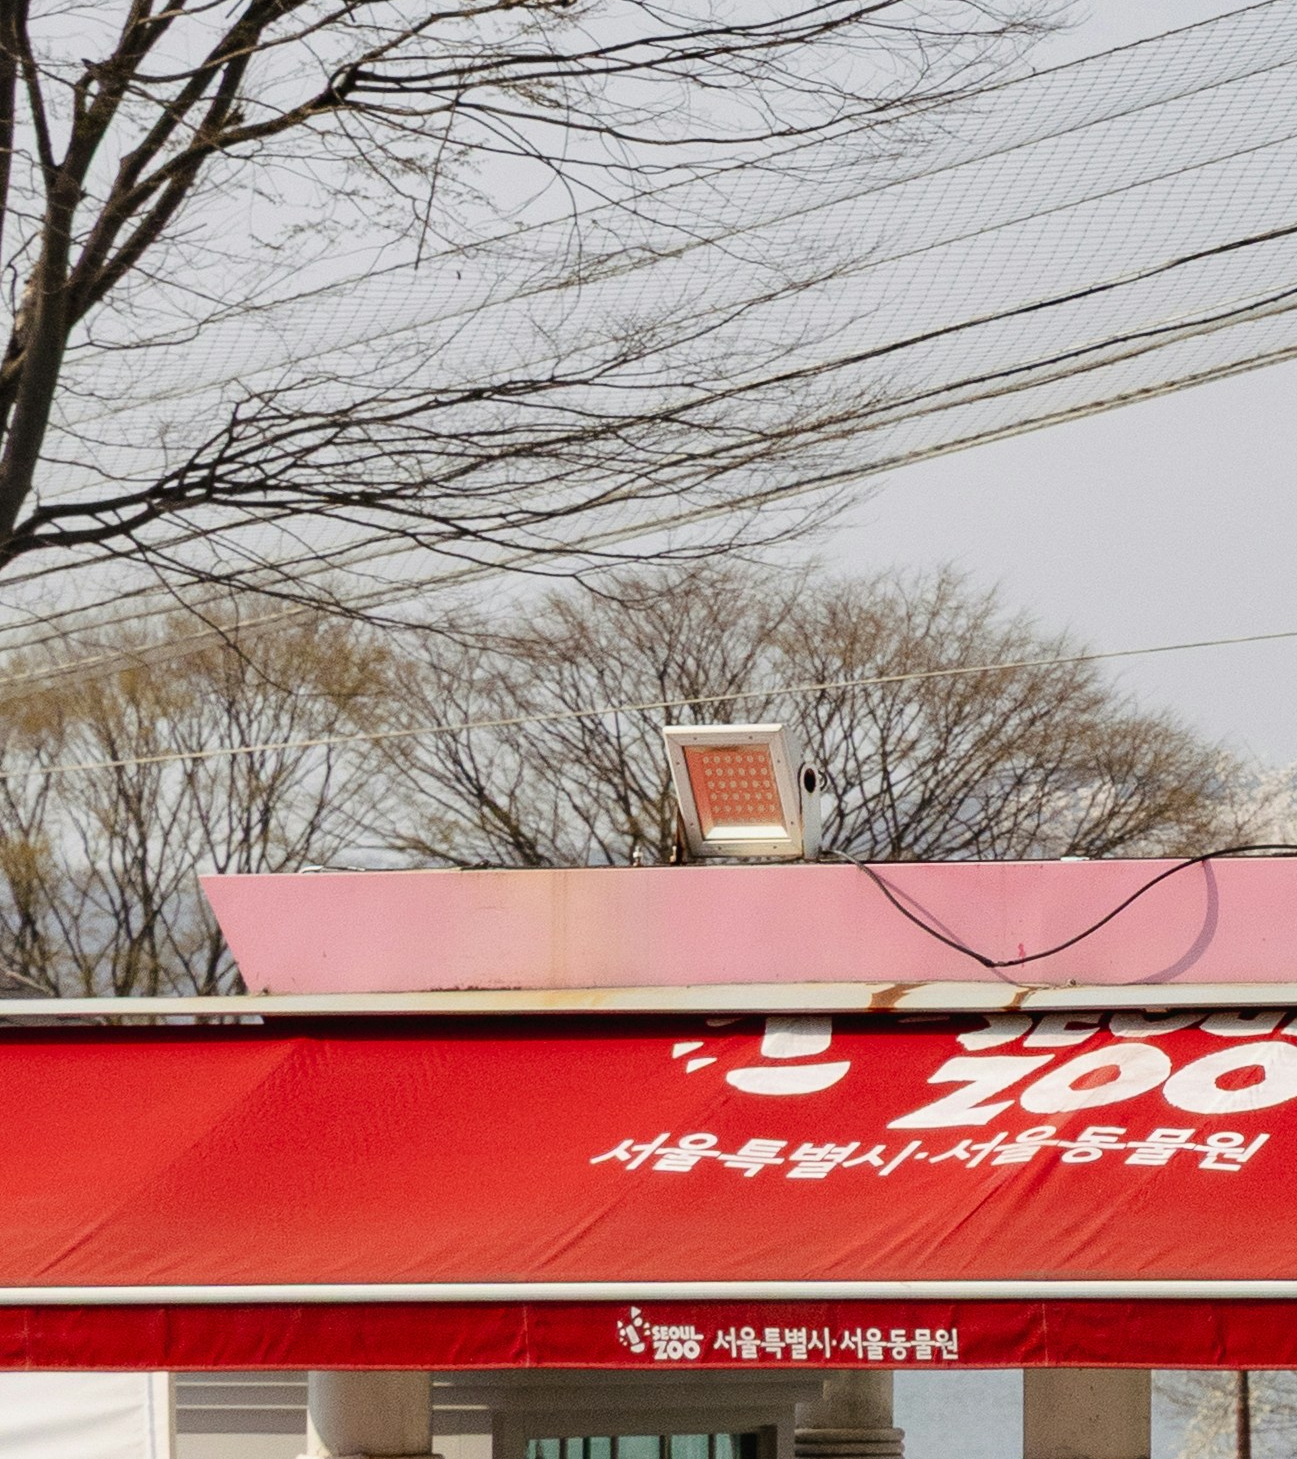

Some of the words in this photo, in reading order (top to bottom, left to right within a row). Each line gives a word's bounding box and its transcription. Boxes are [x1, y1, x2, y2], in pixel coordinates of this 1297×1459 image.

[590, 1124, 1271, 1179] 서울특별시·서울동물원
[651, 1325, 704, 1341] SEOUL
[713, 1326, 959, 1361] 서울특별시·서울동물원
[653, 1340, 702, 1360] ZOO
